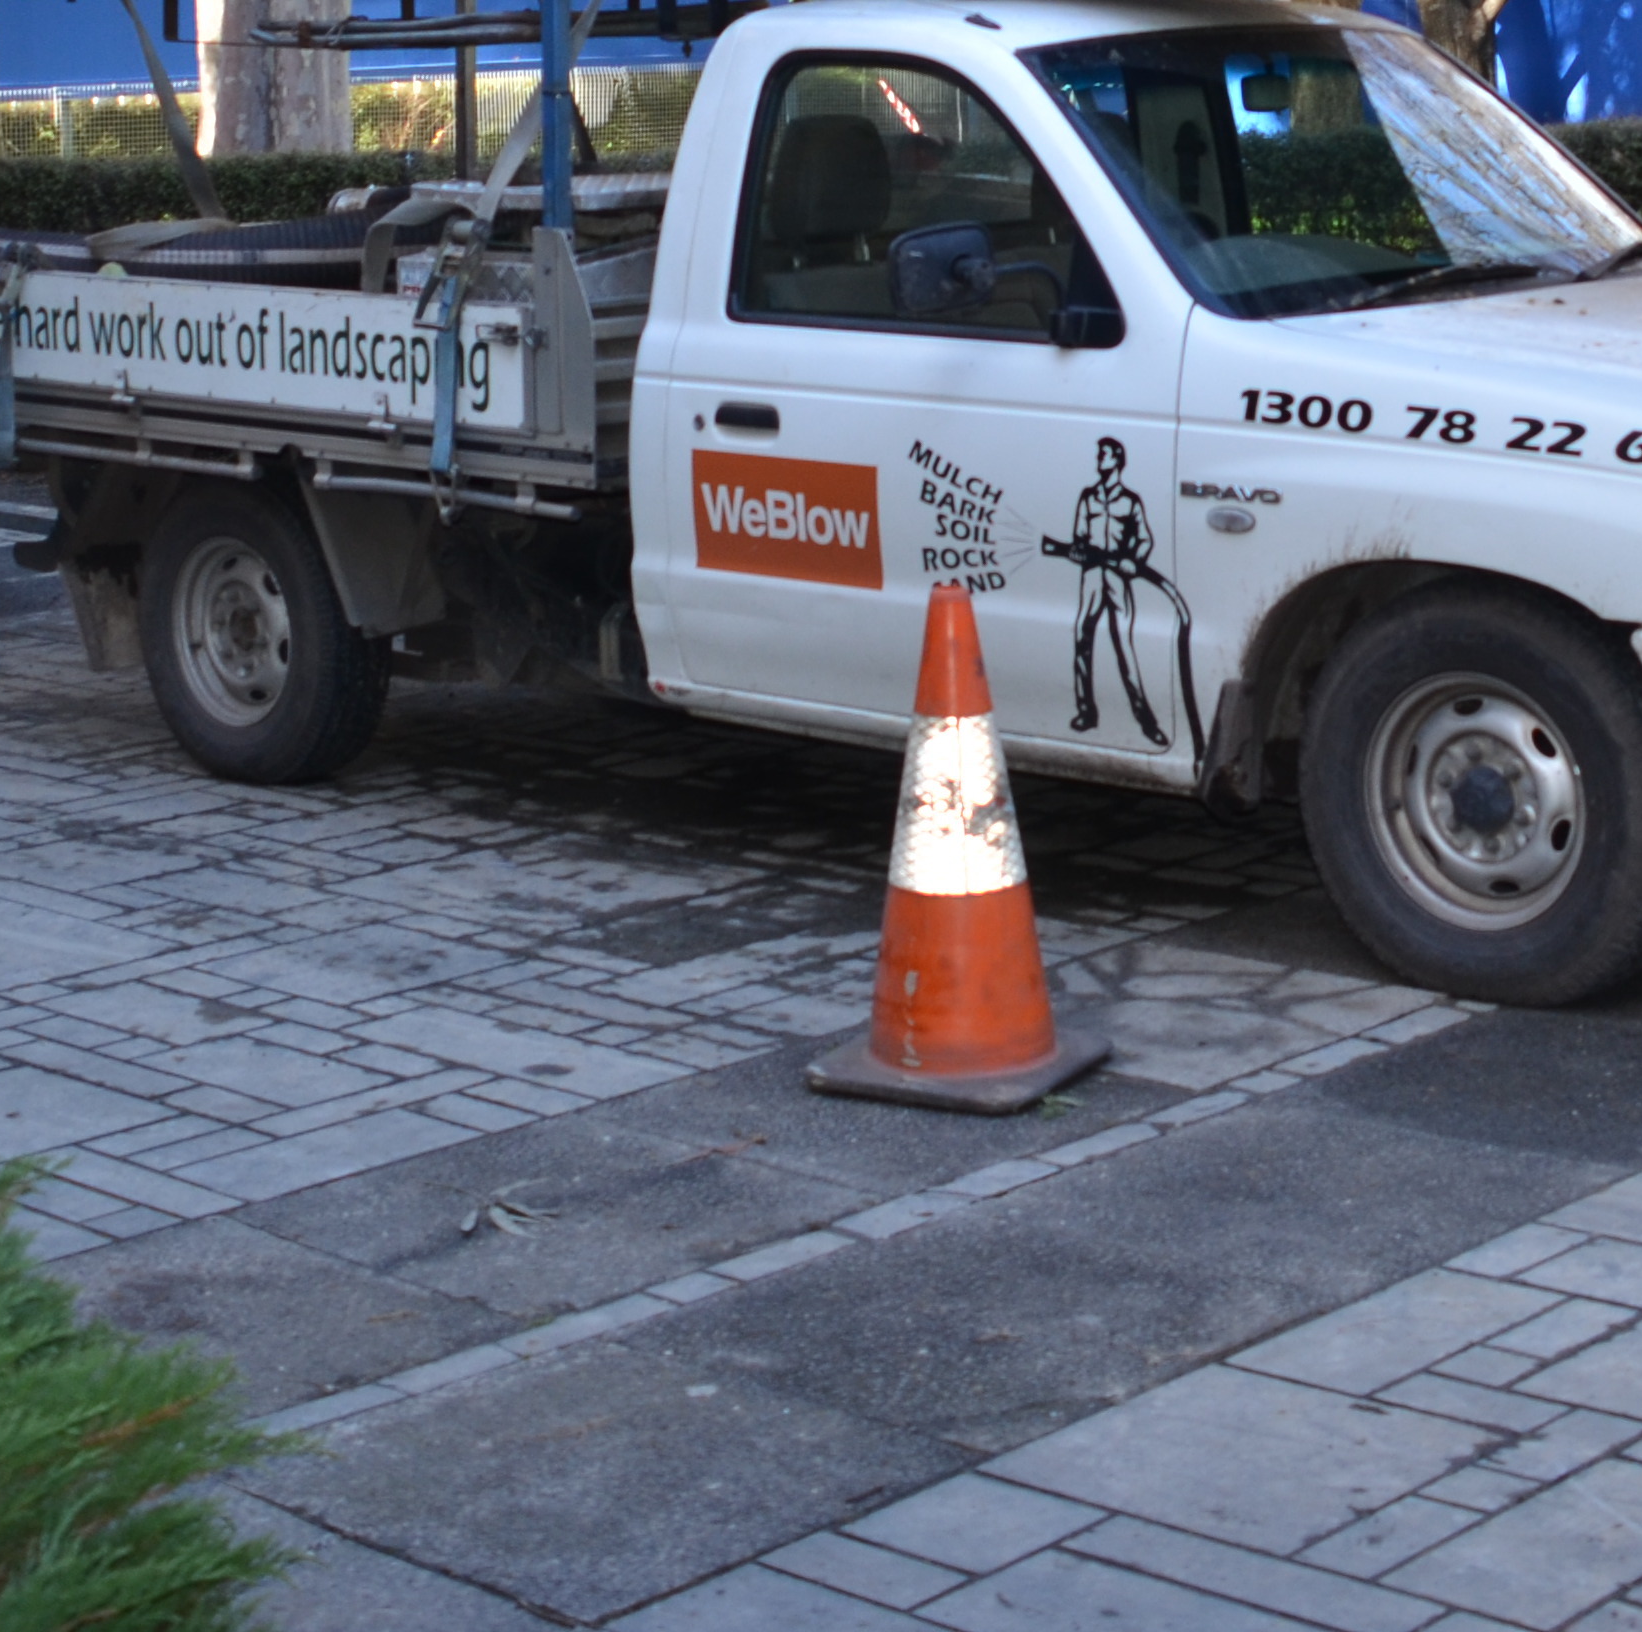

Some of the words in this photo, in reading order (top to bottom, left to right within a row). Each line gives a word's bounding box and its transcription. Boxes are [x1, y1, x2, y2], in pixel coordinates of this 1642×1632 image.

[14, 294, 81, 353] hard
[89, 301, 167, 362] work
[175, 311, 228, 367] out
[237, 307, 269, 370] of
[279, 310, 490, 412] landscapg
[1241, 388, 1374, 433] 1300
[1405, 405, 1477, 445] 78
[1505, 416, 1587, 457] 22
[908, 440, 1004, 505] MULCH
[1180, 479, 1282, 505] BRAVO
[700, 482, 870, 549] WeBlow
[919, 478, 996, 525] BARK
[935, 513, 996, 545] SOIL
[922, 547, 999, 573] ROCK
[933, 571, 1007, 596] ND
